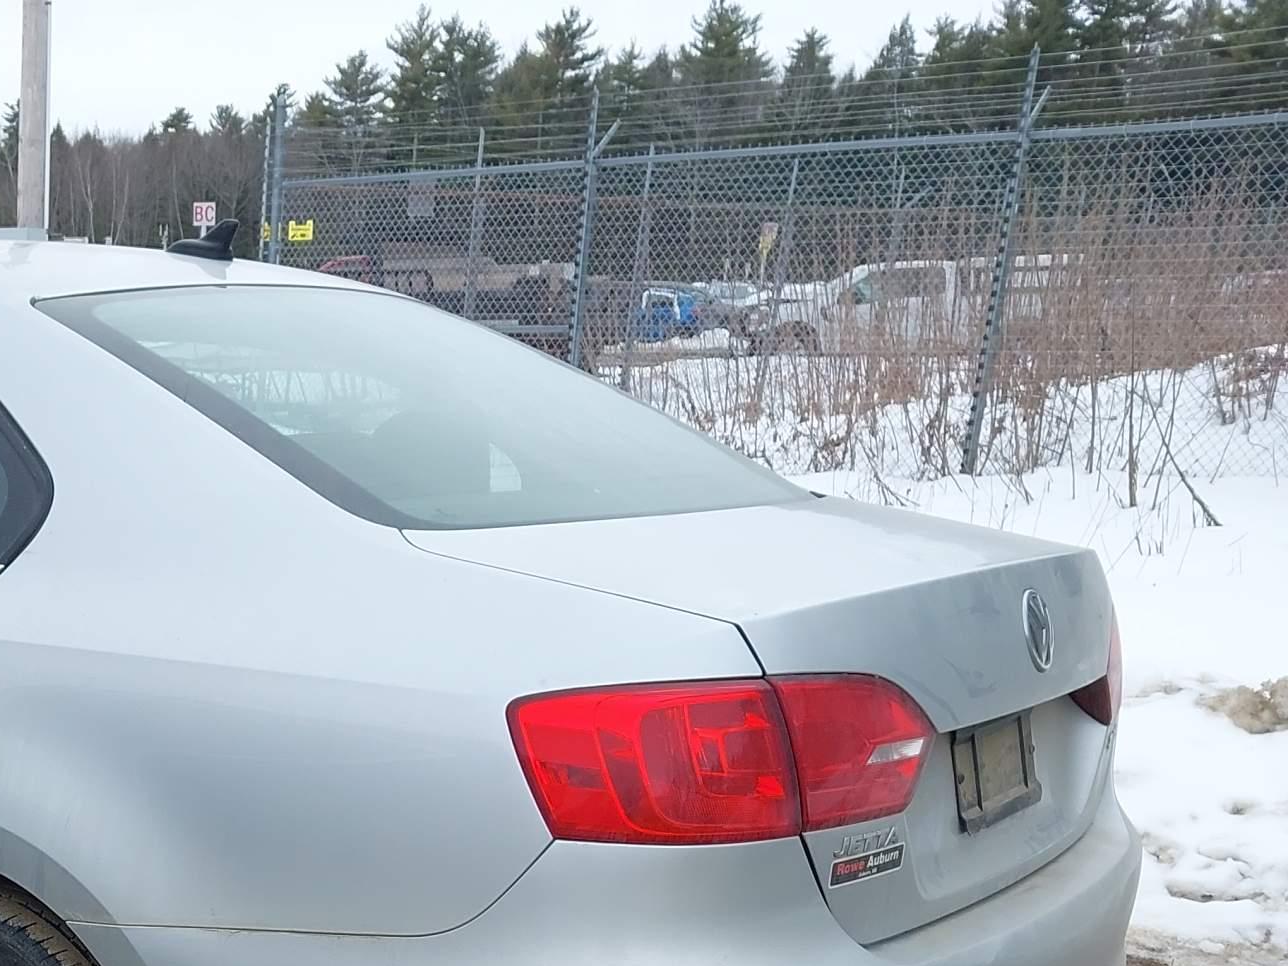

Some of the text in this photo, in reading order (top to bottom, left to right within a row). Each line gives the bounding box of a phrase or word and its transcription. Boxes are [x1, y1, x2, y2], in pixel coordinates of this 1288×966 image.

[194, 205, 215, 222] BC
[832, 826, 898, 858] JETTA
[836, 861, 866, 876] Rowe
[866, 850, 900, 868] Auburn
